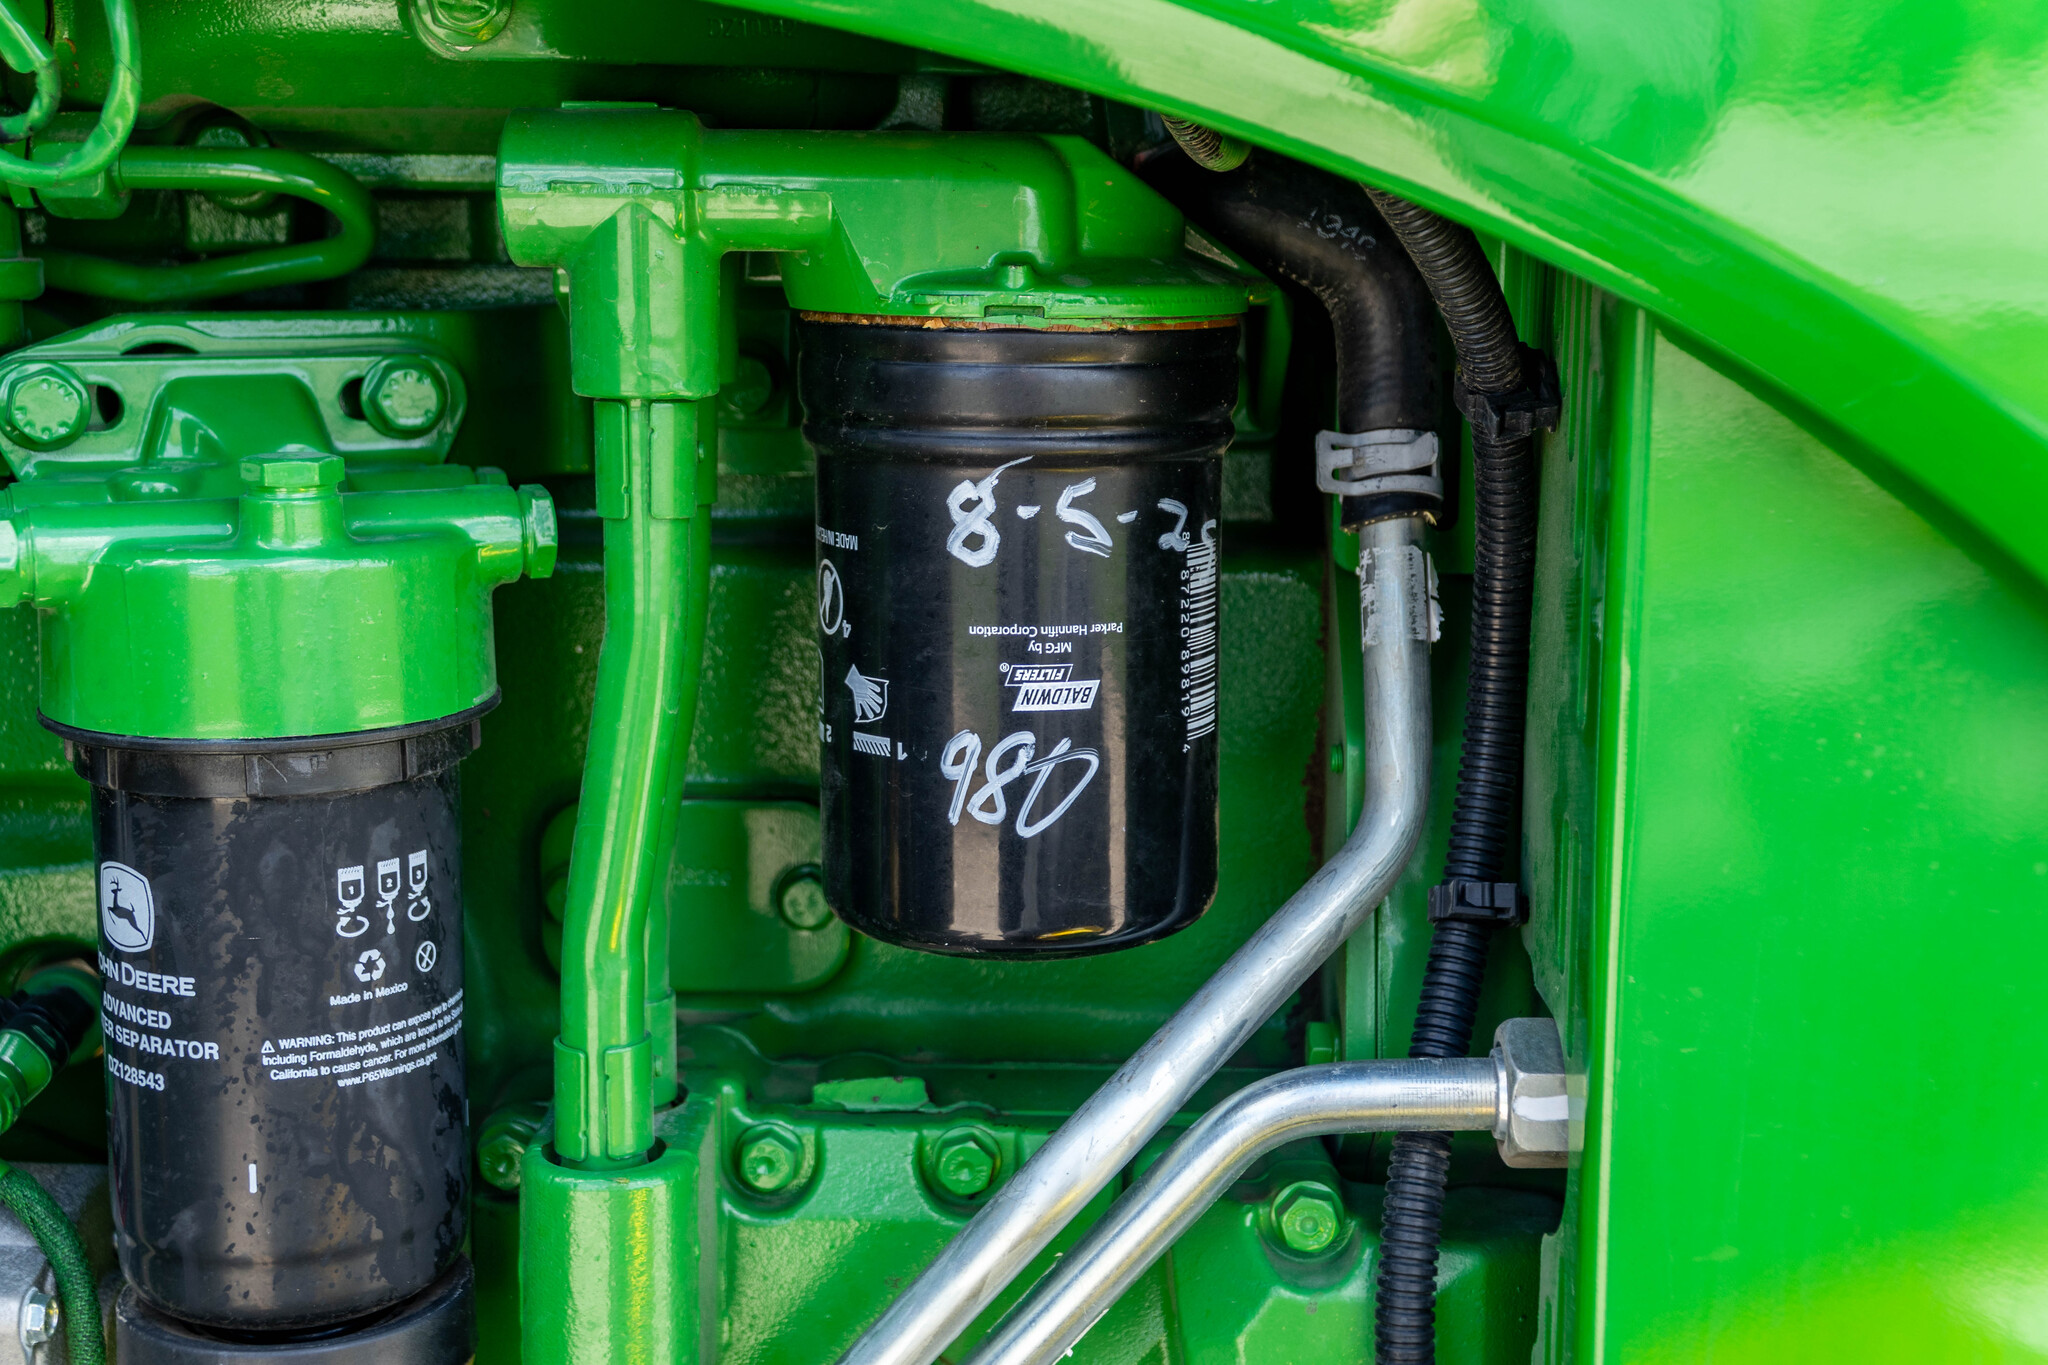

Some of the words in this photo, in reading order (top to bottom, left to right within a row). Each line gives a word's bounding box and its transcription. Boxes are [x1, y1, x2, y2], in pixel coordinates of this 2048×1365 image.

[828, 530, 835, 547] IN
[835, 531, 859, 551] MADE
[1180, 570, 1190, 638] 87220
[842, 619, 852, 638] 4
[968, 624, 1038, 638] Corporation
[1040, 624, 1088, 637] Hannifin
[1089, 621, 1123, 635] Parker
[1027, 640, 1043, 654] by
[1045, 641, 1072, 653] MFG
[1013, 668, 1066, 681] FILTERS
[1180, 649, 1191, 717] 89819
[1020, 686, 1094, 706] BALDWIN
[826, 723, 832, 743] 2
[897, 741, 909, 760] 1
[386, 878, 393, 888] 2
[416, 869, 422, 880] 3
[348, 885, 354, 895] 1
[98, 949, 120, 982] OHN
[329, 992, 362, 1006] Made
[363, 990, 373, 1001] in
[375, 982, 409, 999] Mexico
[103, 990, 172, 1030] ADVANCED
[278, 1034, 335, 1050] WARNING:
[336, 1031, 357, 1043] This
[358, 1023, 391, 1041] product
[392, 1020, 407, 1031] can
[407, 1011, 432, 1026] expose
[431, 1005, 442, 1019] you
[442, 1001, 448, 1012] to
[115, 1024, 220, 1061] SEPARATOR
[309, 1042, 379, 1062] Formaldehyde,
[380, 1035, 404, 1049] which
[404, 1031, 417, 1042] are
[417, 1022, 438, 1038] known
[437, 1019, 444, 1029] to
[443, 1014, 452, 1025] the
[270, 1066, 319, 1080] California
[320, 1065, 331, 1075] to
[331, 1061, 361, 1074] cause
[362, 1053, 393, 1068] cancer.
[394, 1049, 408, 1060] For
[408, 1042, 427, 1056] more
[107, 1053, 166, 1092] DZ128543
